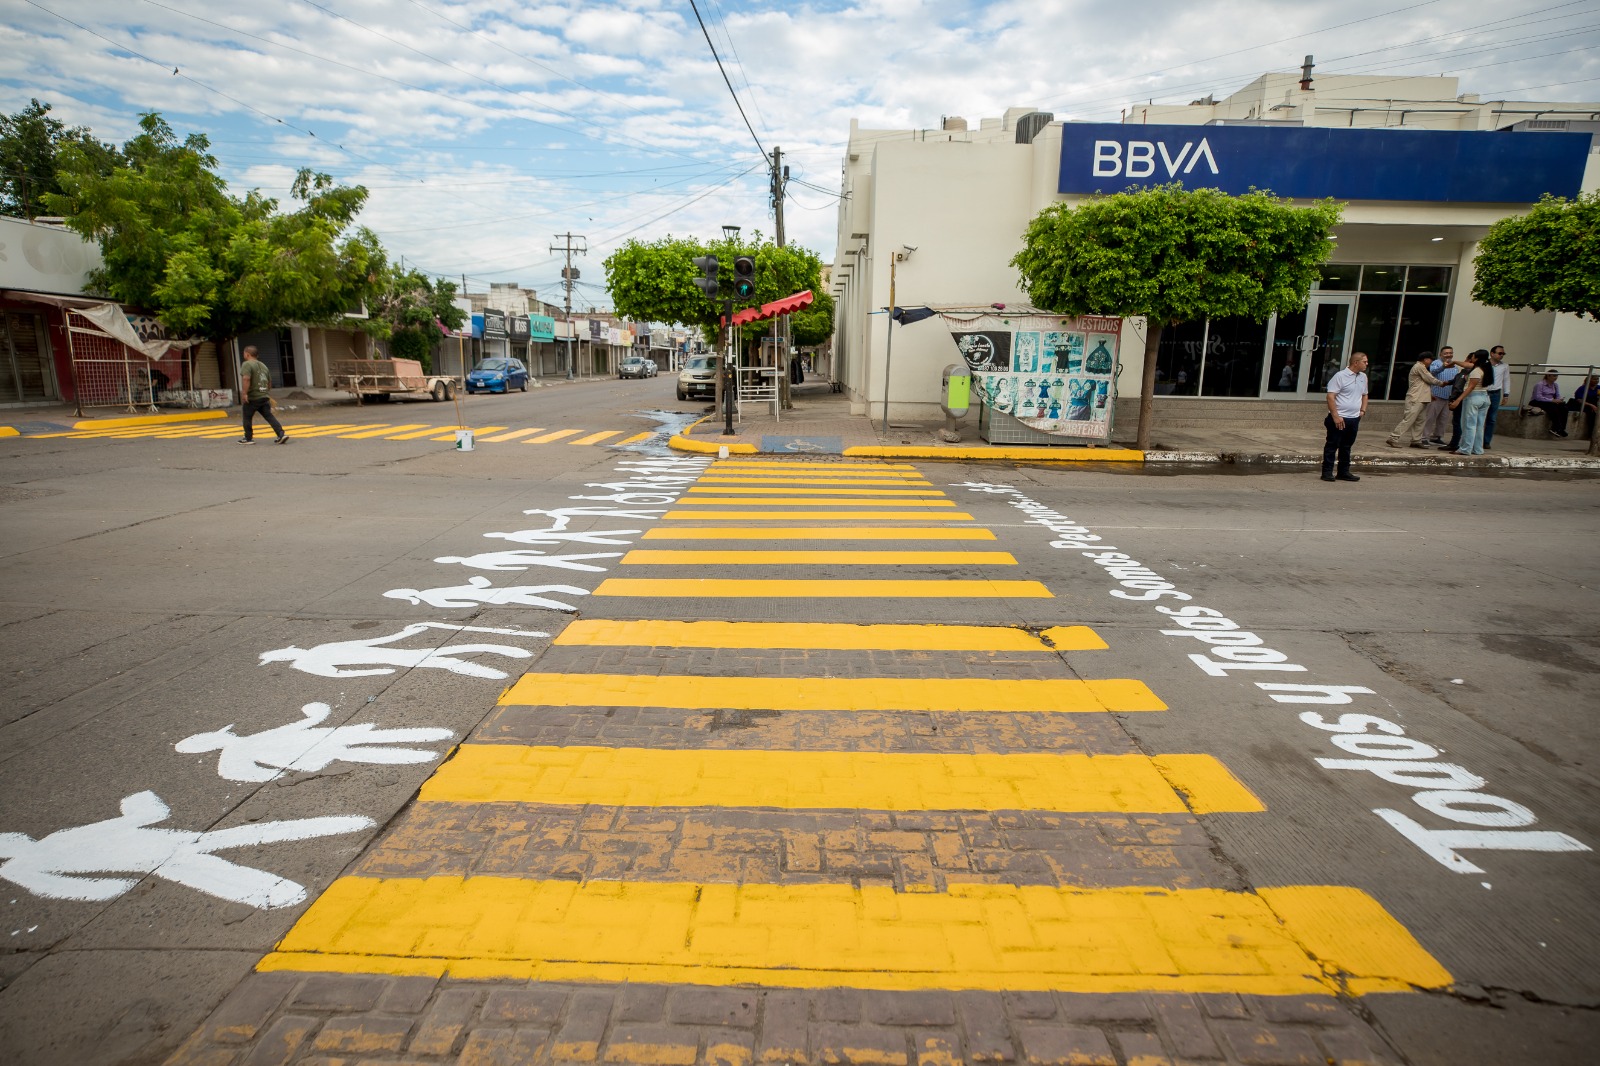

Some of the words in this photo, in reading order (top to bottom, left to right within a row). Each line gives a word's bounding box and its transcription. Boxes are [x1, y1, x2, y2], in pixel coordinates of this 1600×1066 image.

[1092, 137, 1219, 179] BBVA
[1076, 315, 1120, 332] VESTIDOS
[1060, 422, 1105, 437] CARTERAS
[1081, 551, 1193, 601] Somos
[1154, 605, 1309, 677] Todas
[1253, 681, 1377, 705] y
[1298, 710, 1591, 874] Todos
